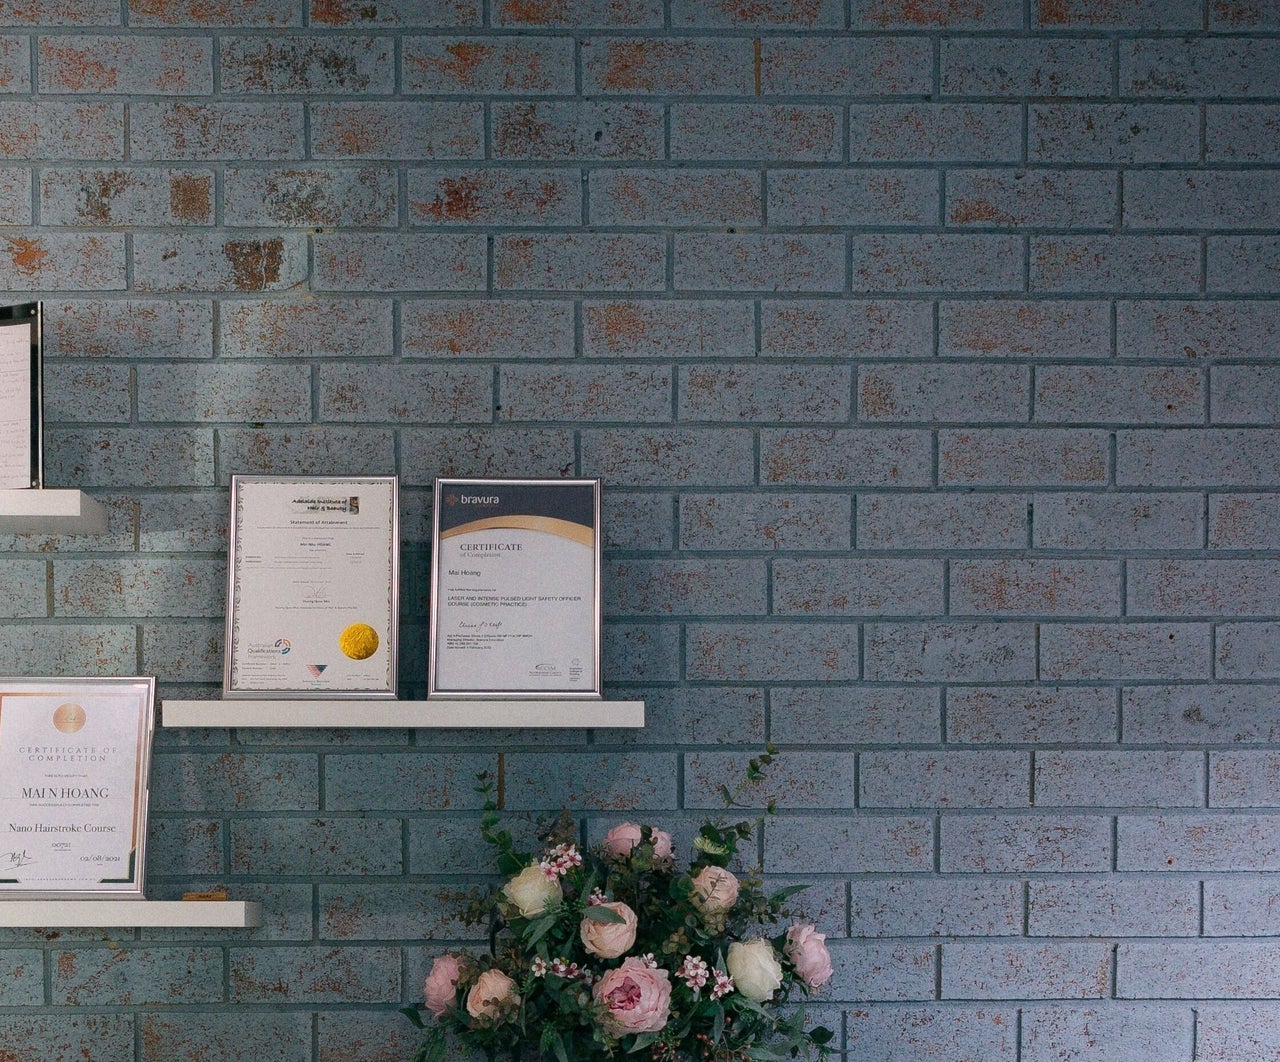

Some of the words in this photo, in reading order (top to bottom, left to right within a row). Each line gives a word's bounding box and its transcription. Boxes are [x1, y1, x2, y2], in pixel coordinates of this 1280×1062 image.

[461, 494, 500, 504] bravura
[460, 543, 522, 551] CERTIFICATE
[18, 746, 96, 754] CERTIFICATE
[103, 746, 118, 754] OF
[28, 754, 106, 762] COMPLETION
[22, 787, 45, 799] MAI
[48, 787, 57, 799] N
[61, 787, 109, 799] HOANG
[9, 823, 33, 833] Nano
[34, 823, 81, 833] Hairstroke
[83, 823, 116, 833] Course
